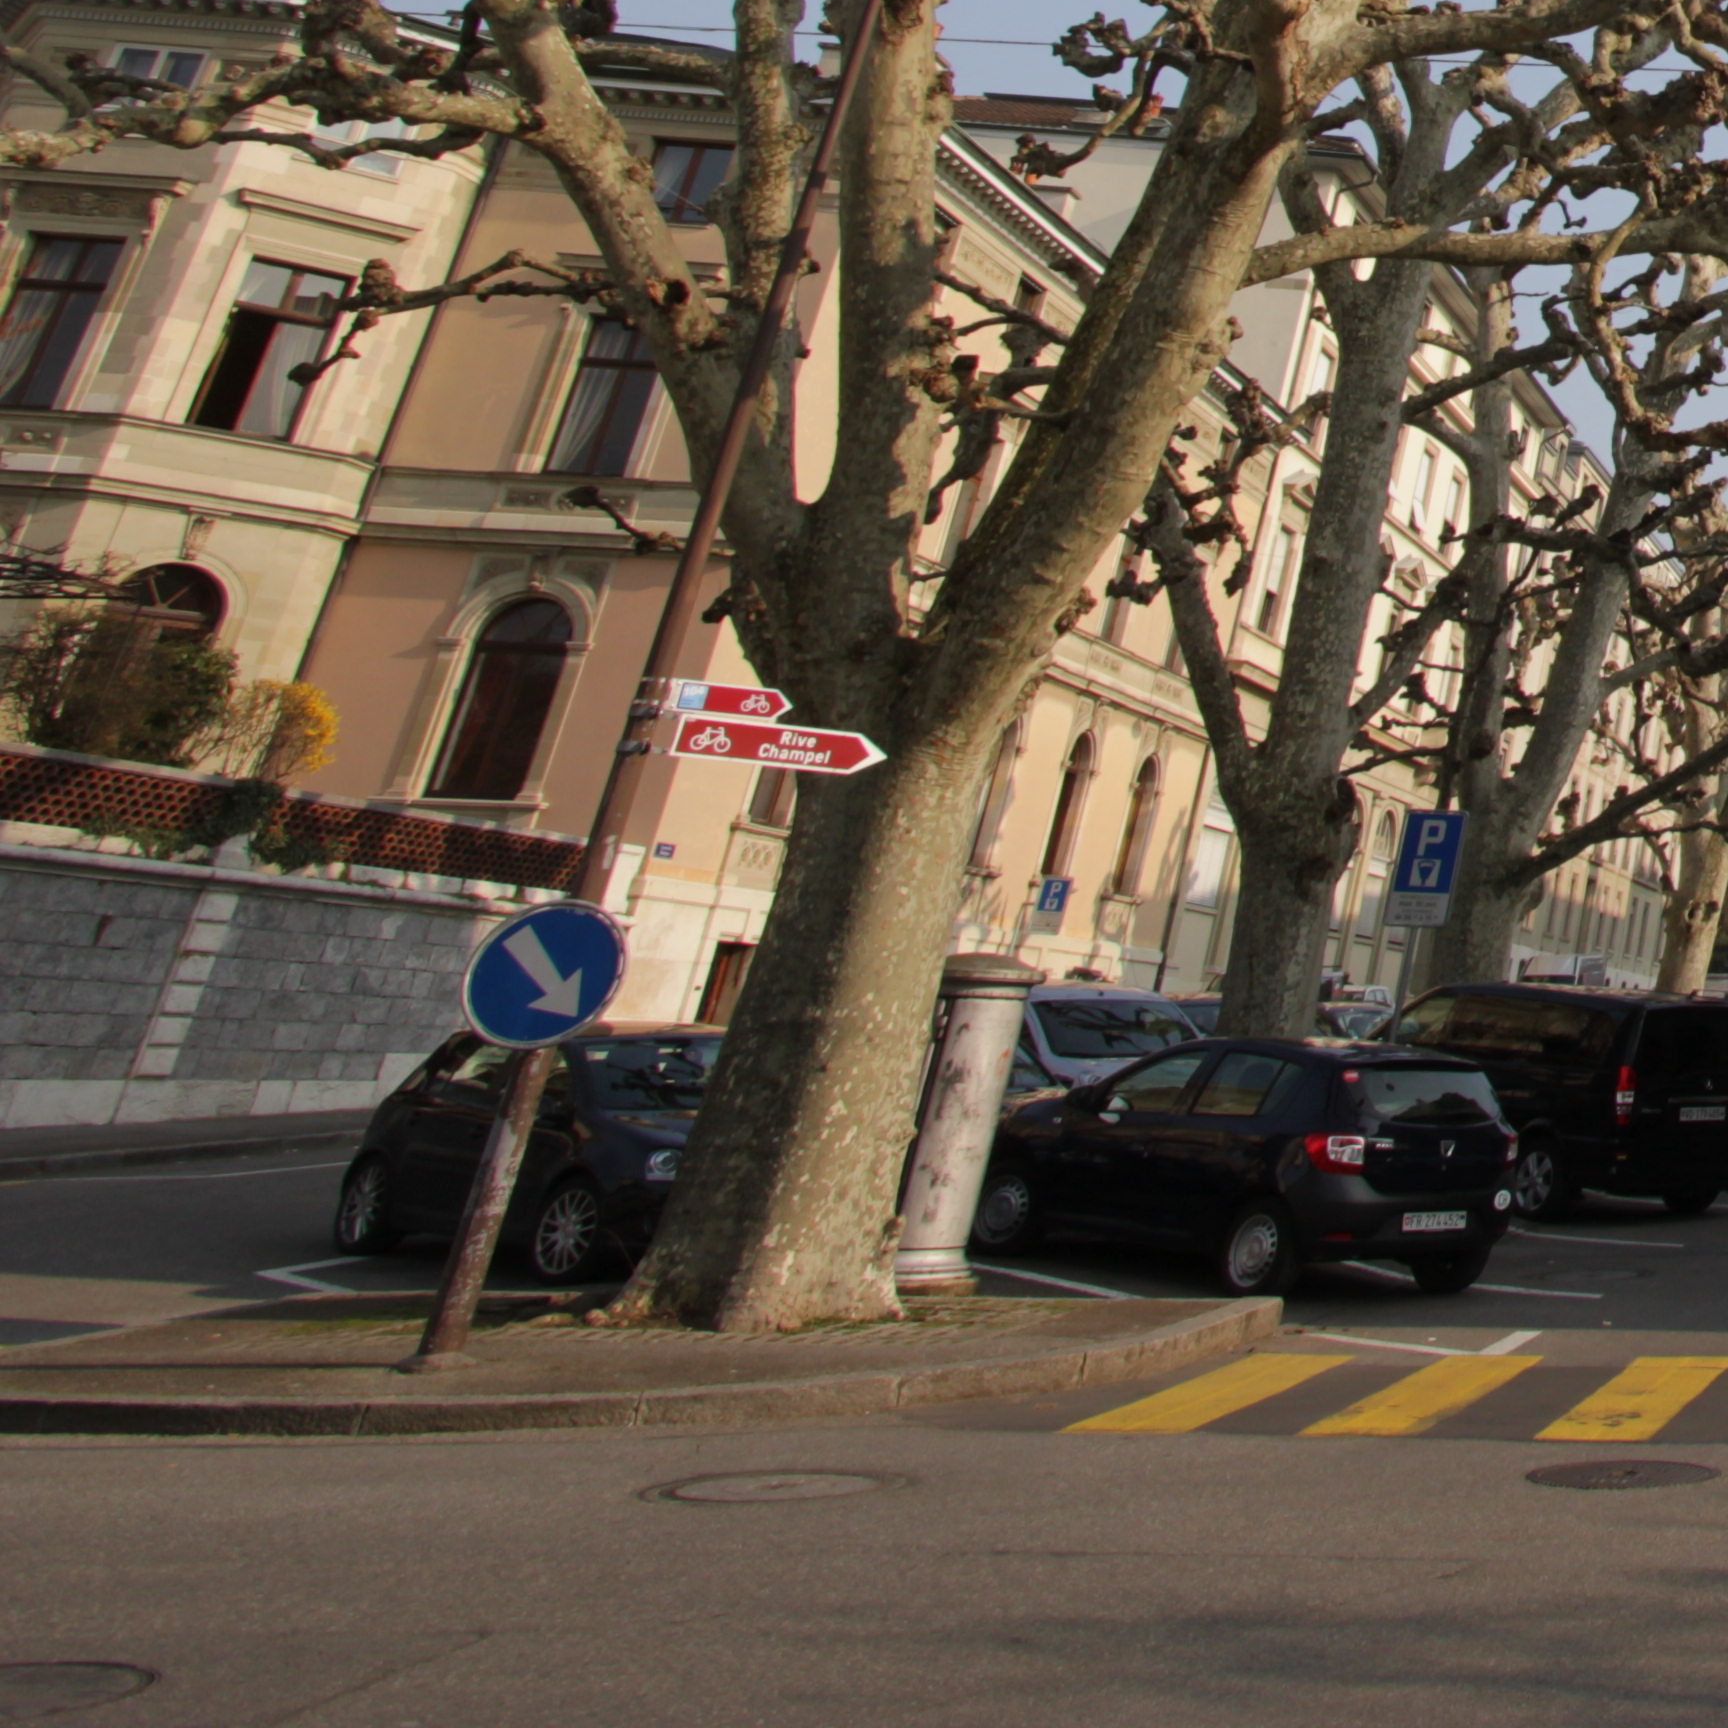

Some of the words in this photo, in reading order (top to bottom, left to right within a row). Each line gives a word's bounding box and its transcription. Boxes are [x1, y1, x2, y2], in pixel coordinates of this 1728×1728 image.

[779, 730, 818, 748] Rive
[758, 743, 831, 764] Champel
[1417, 819, 1447, 856] P
[1050, 882, 1063, 898] P
